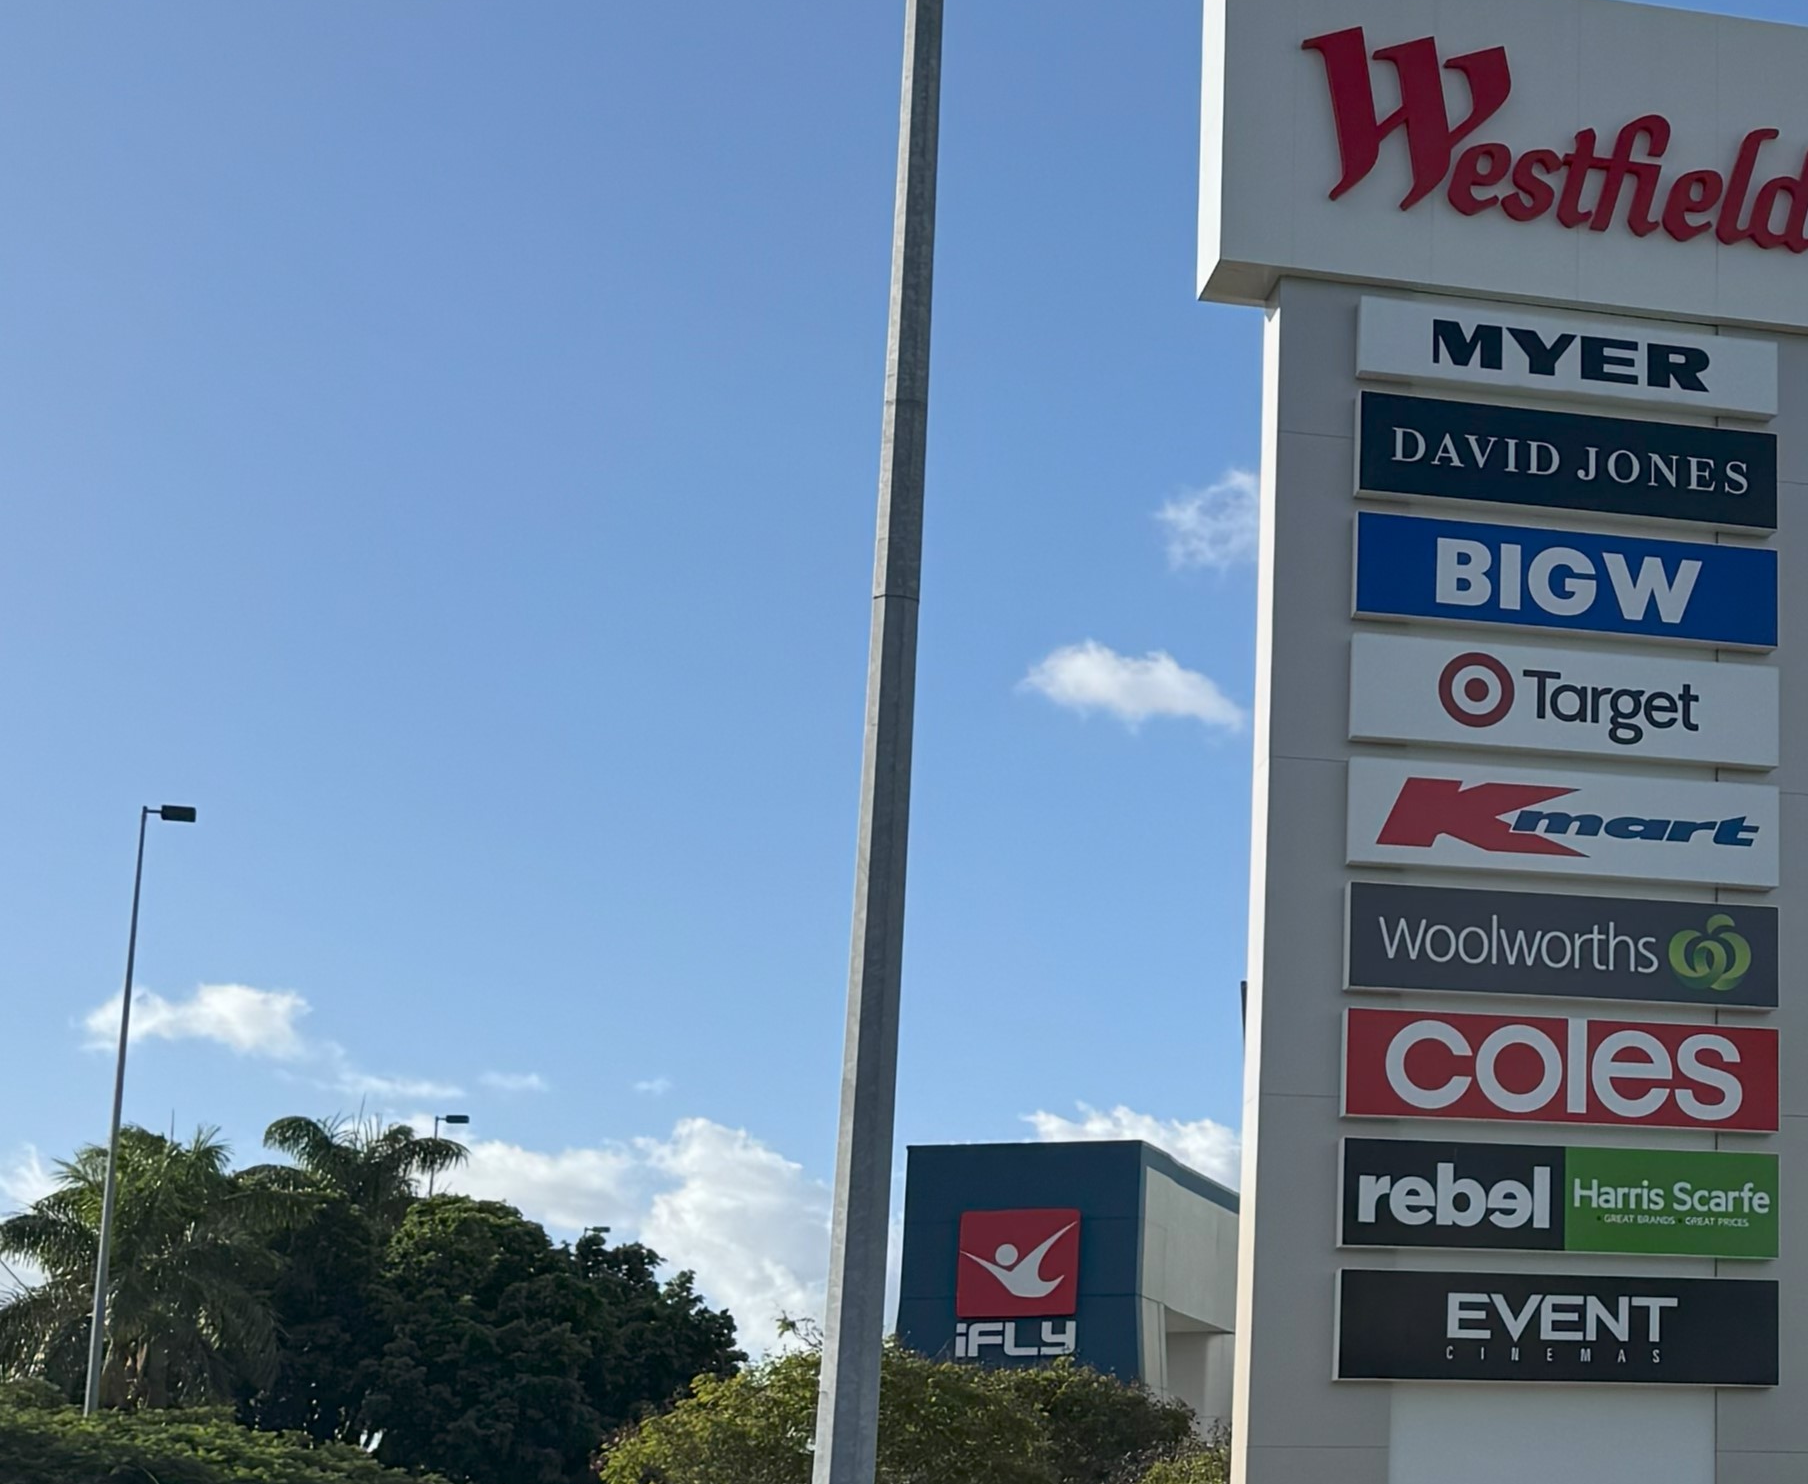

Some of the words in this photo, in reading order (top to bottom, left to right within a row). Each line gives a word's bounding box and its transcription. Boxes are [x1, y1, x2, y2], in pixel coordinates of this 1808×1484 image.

[1433, 319, 1710, 393] MYER
[1391, 426, 1561, 476] DAVID
[1576, 446, 1749, 495] JONES
[1522, 669, 1700, 745] Target
[1376, 776, 1760, 858] Kmart
[1378, 914, 1660, 974] Woolworths
[1385, 1018, 1743, 1121] coles
[1357, 1162, 1551, 1229] rebel
[1573, 1178, 1664, 1210] Harris
[1672, 1181, 1770, 1214] Scarfe
[1718, 1218, 1749, 1227] PRICES
[1446, 1292, 1679, 1343] EVENT
[1445, 1345, 1661, 1363] CINEMAS
